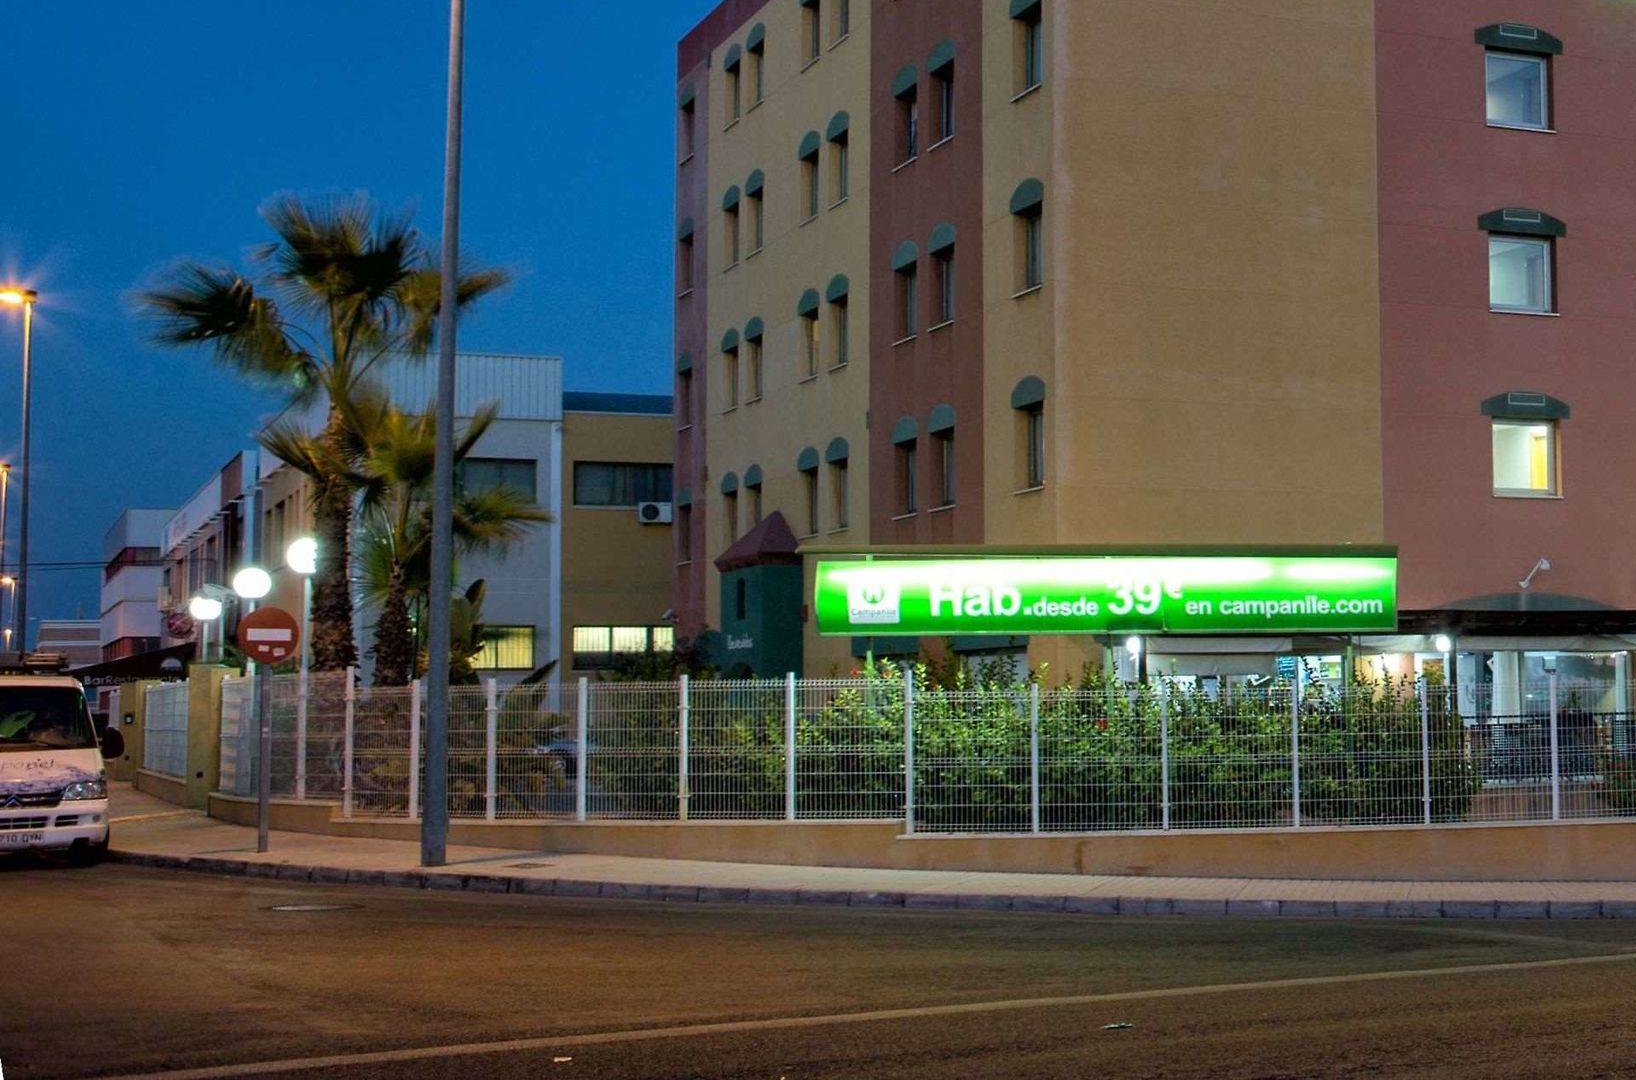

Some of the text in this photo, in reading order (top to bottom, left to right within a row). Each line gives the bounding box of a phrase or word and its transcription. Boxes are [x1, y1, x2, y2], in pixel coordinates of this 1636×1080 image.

[1032, 595, 1099, 616] desde
[1184, 599, 1212, 615] en
[1219, 595, 1383, 619] campanile.com
